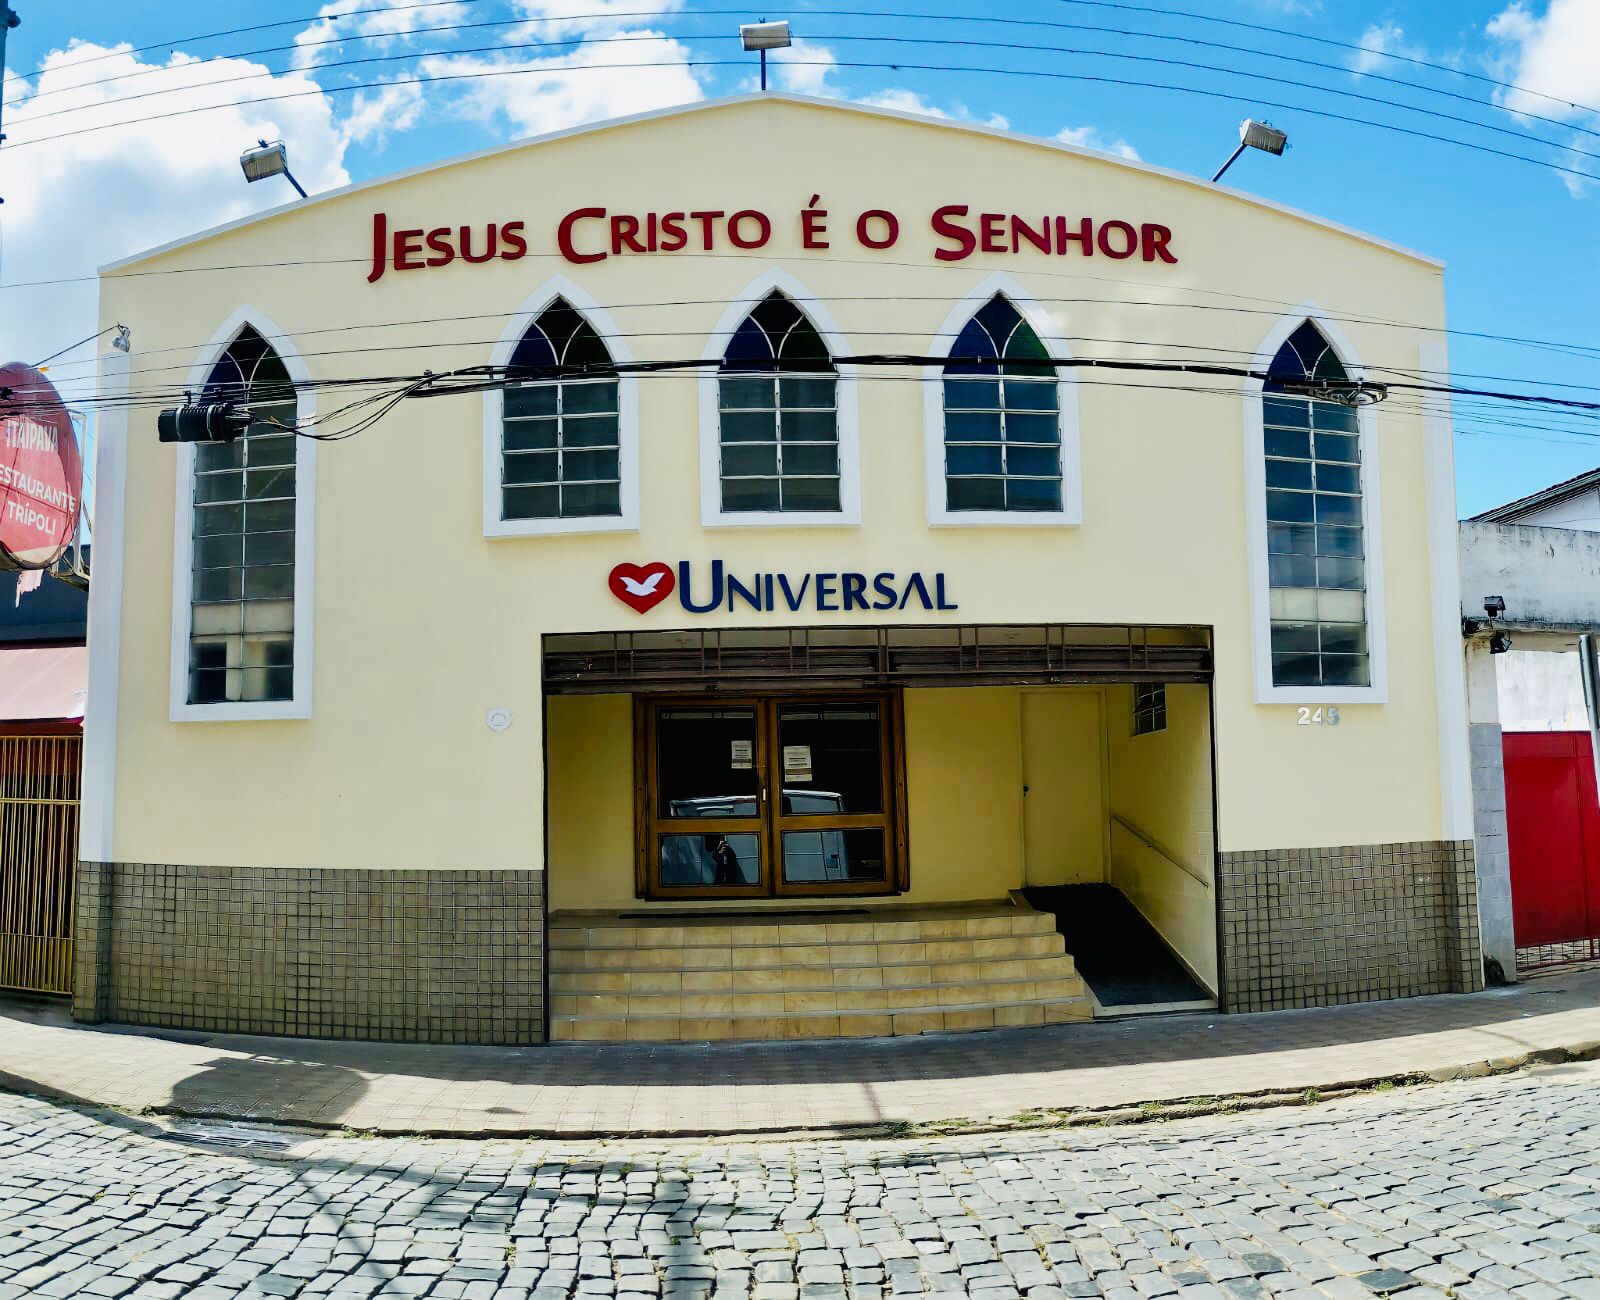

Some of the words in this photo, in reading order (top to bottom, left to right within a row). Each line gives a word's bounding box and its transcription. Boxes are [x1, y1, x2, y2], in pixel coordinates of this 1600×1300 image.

[367, 212, 527, 284] JESUS
[557, 207, 772, 264] CRISTO
[800, 193, 830, 249] É
[856, 209, 899, 250] O
[931, 204, 1179, 264] SENHOR
[6, 419, 59, 453] ITAIPAVA
[0, 463, 77, 513] ESTAURANTE
[7, 500, 57, 536] TRÍPOLI
[678, 559, 959, 614] UNIVERSAL
[1297, 705, 1341, 726] 245
